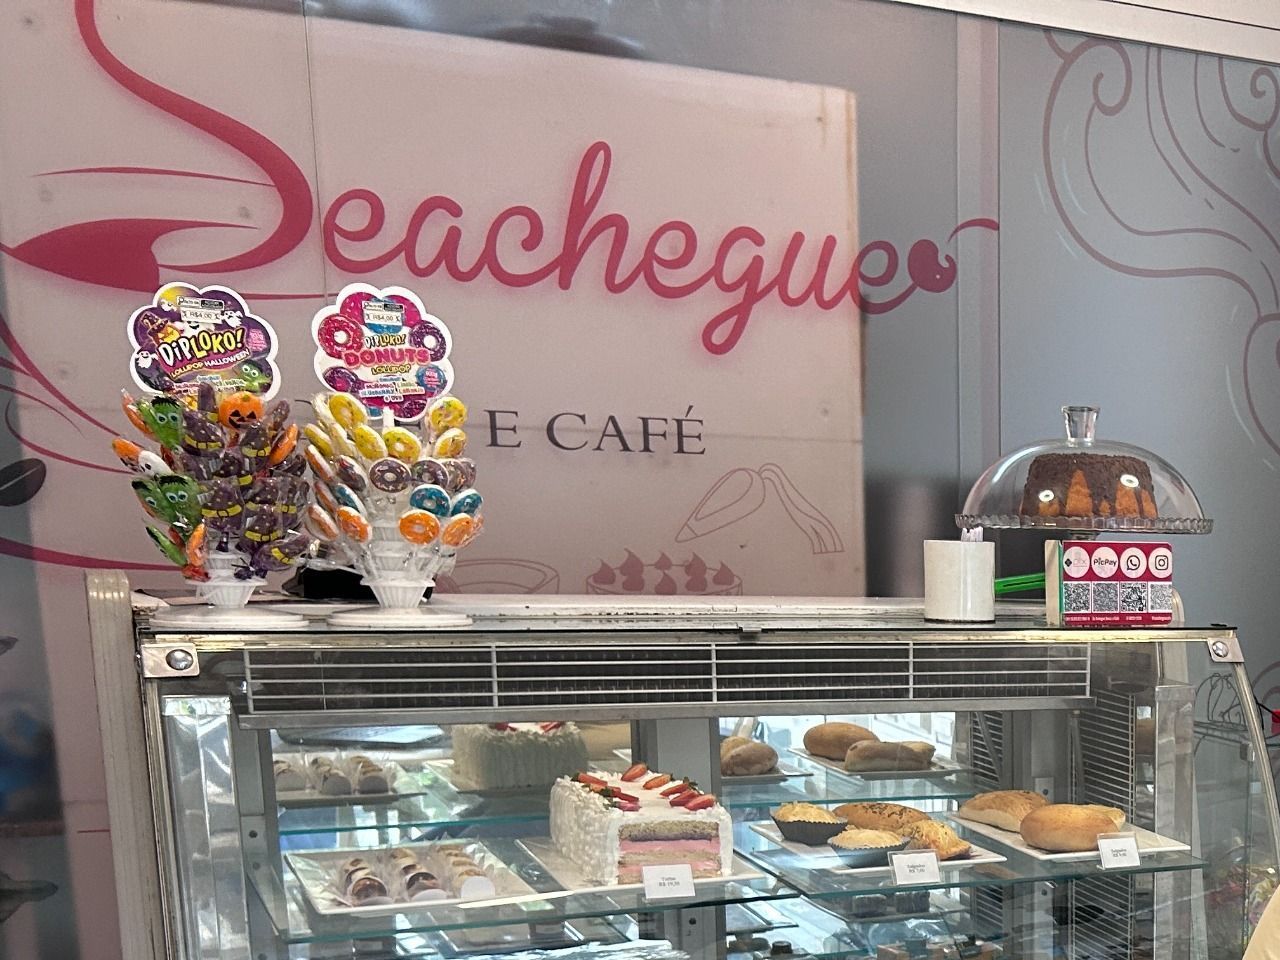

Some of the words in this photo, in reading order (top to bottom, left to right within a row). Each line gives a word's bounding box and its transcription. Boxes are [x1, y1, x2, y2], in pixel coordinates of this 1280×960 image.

[170, 361, 204, 380] LOLLIPOP
[204, 348, 250, 370] HALLOWEEN
[342, 347, 431, 368] DONUTS
[371, 363, 411, 375] LOLLIPOP
[484, 409, 523, 449] E
[546, 404, 706, 456] CAFÉ
[1094, 557, 1116, 567] PicPay
